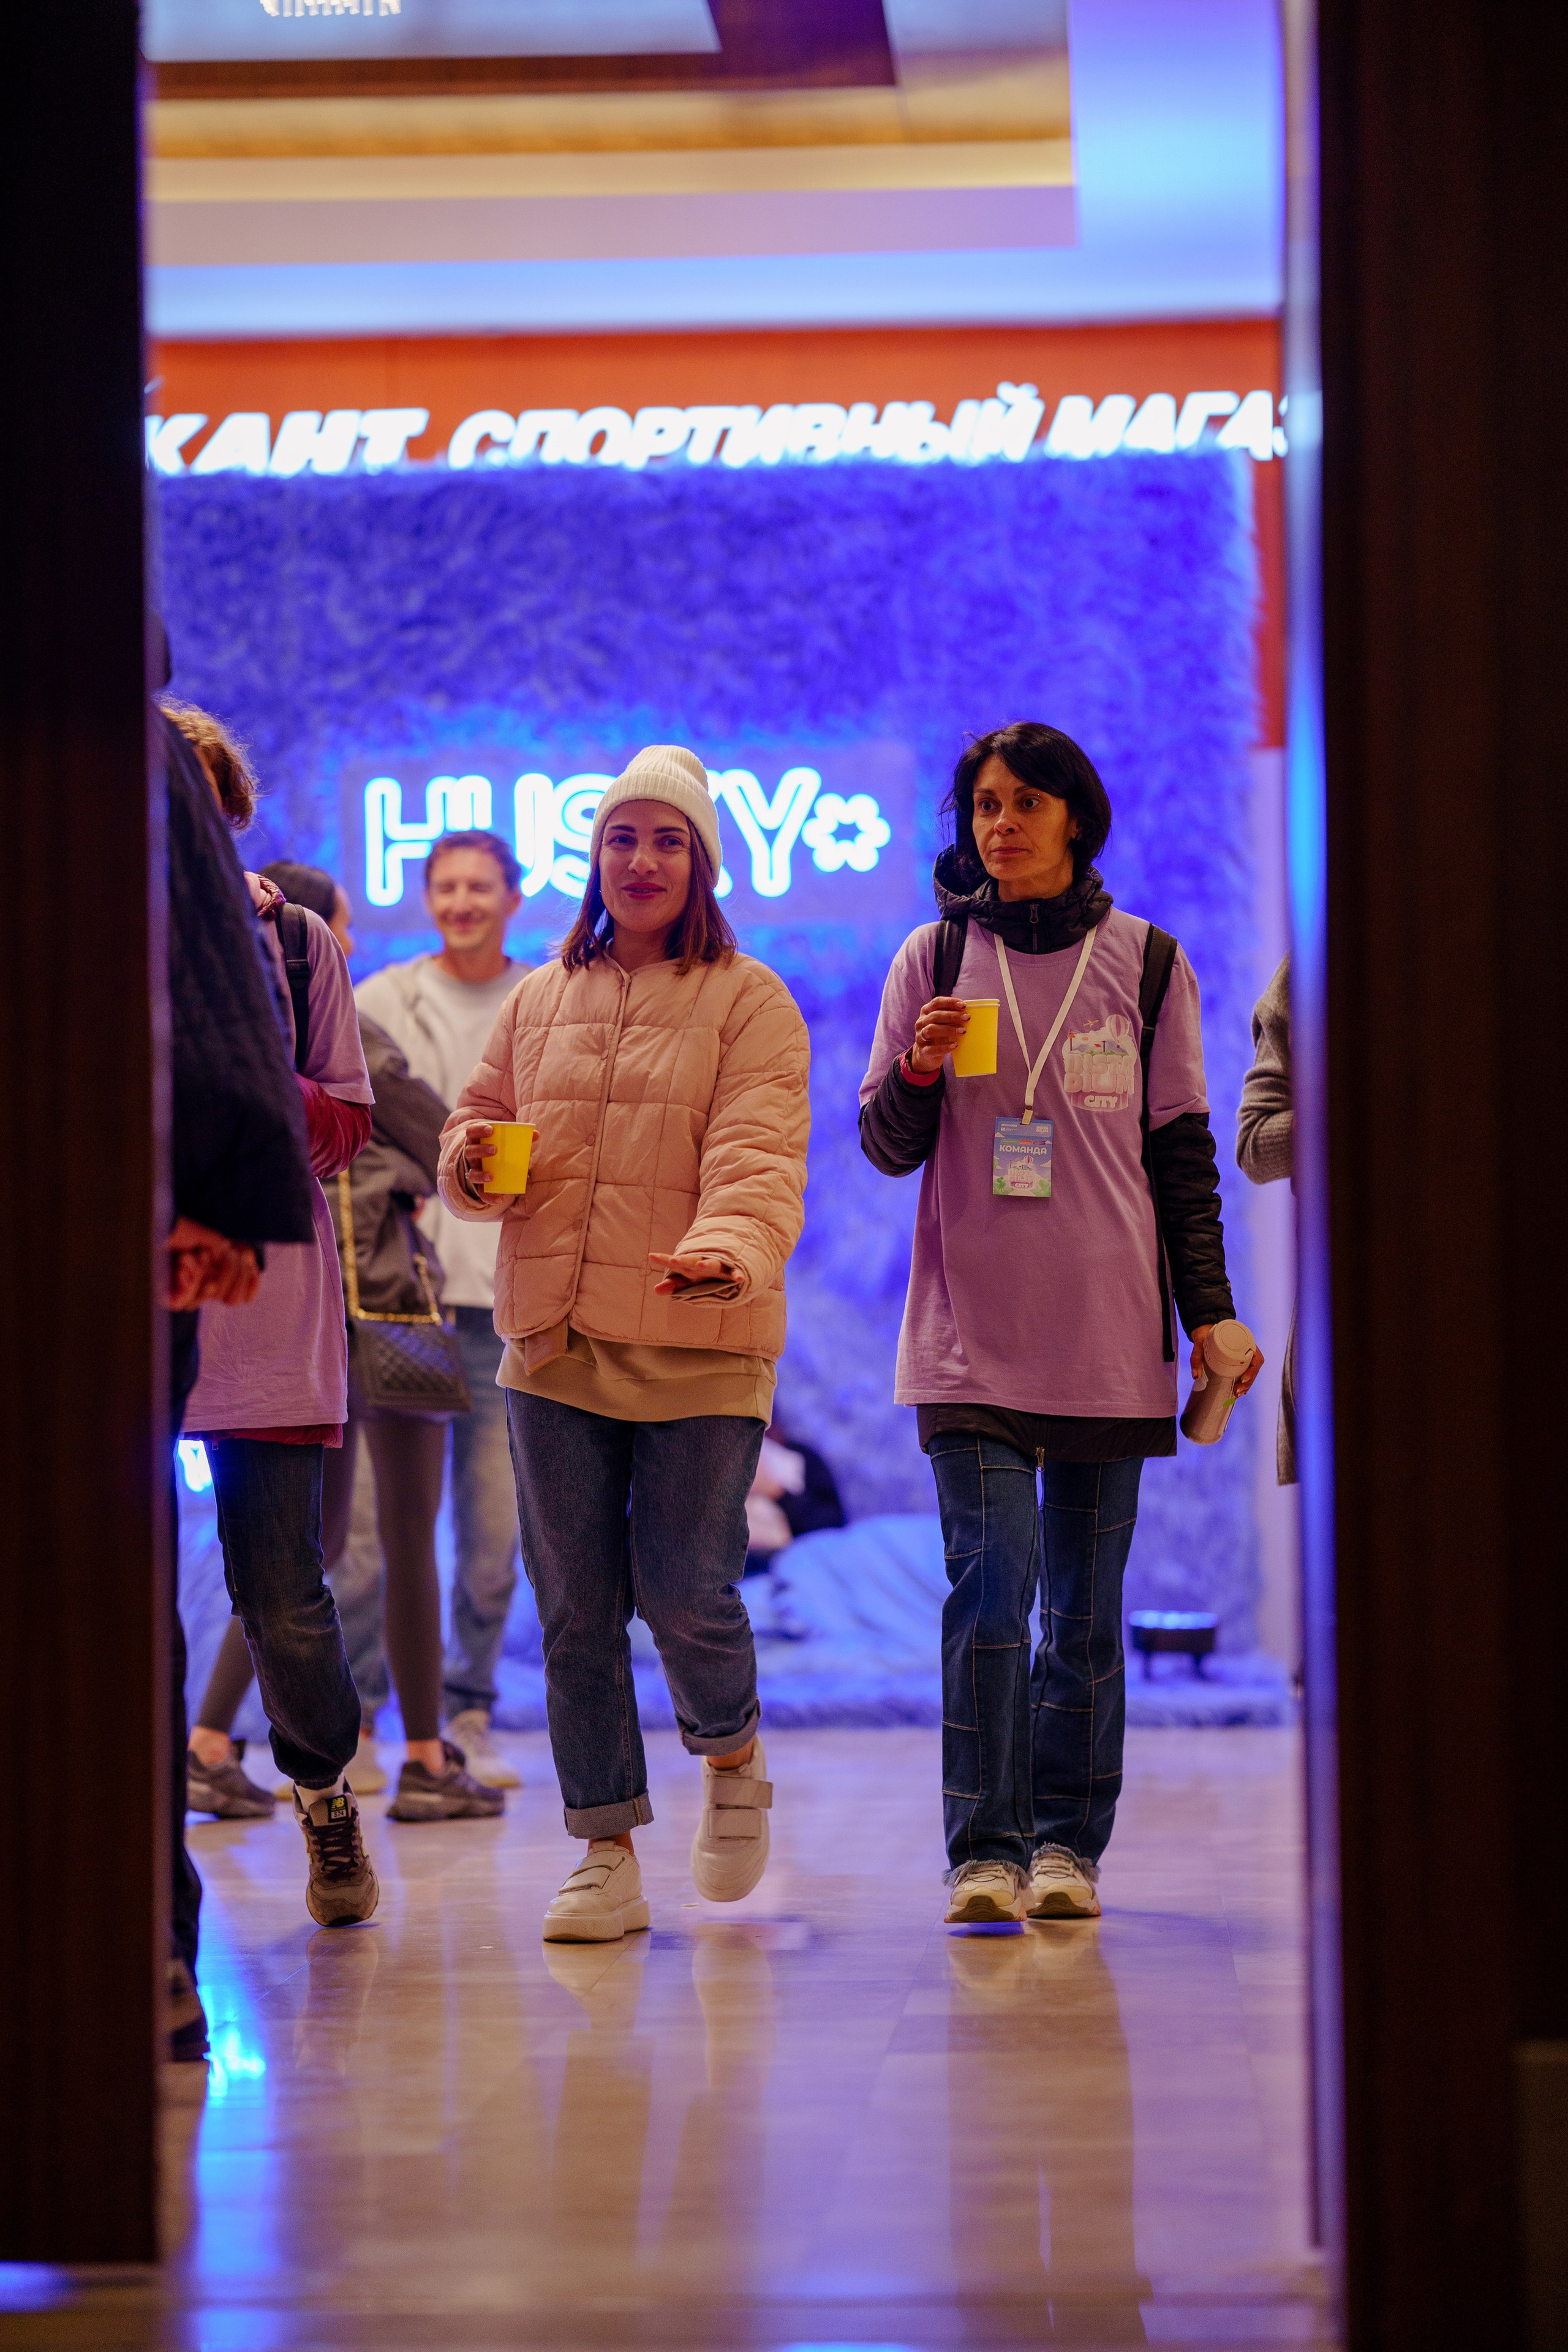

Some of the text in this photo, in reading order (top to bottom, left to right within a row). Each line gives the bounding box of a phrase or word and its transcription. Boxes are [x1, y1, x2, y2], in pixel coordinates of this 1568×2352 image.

[145, 407, 430, 477] КАНТ
[447, 381, 1045, 470] СПОРТИВНЫЙ
[366, 767, 822, 907] HUSY
[1065, 1053, 1134, 1076] INSTA
[1064, 1072, 1134, 1095] DIUM
[1084, 1095, 1118, 1108] CITY
[1000, 1145, 1047, 1155] КОМАНДА
